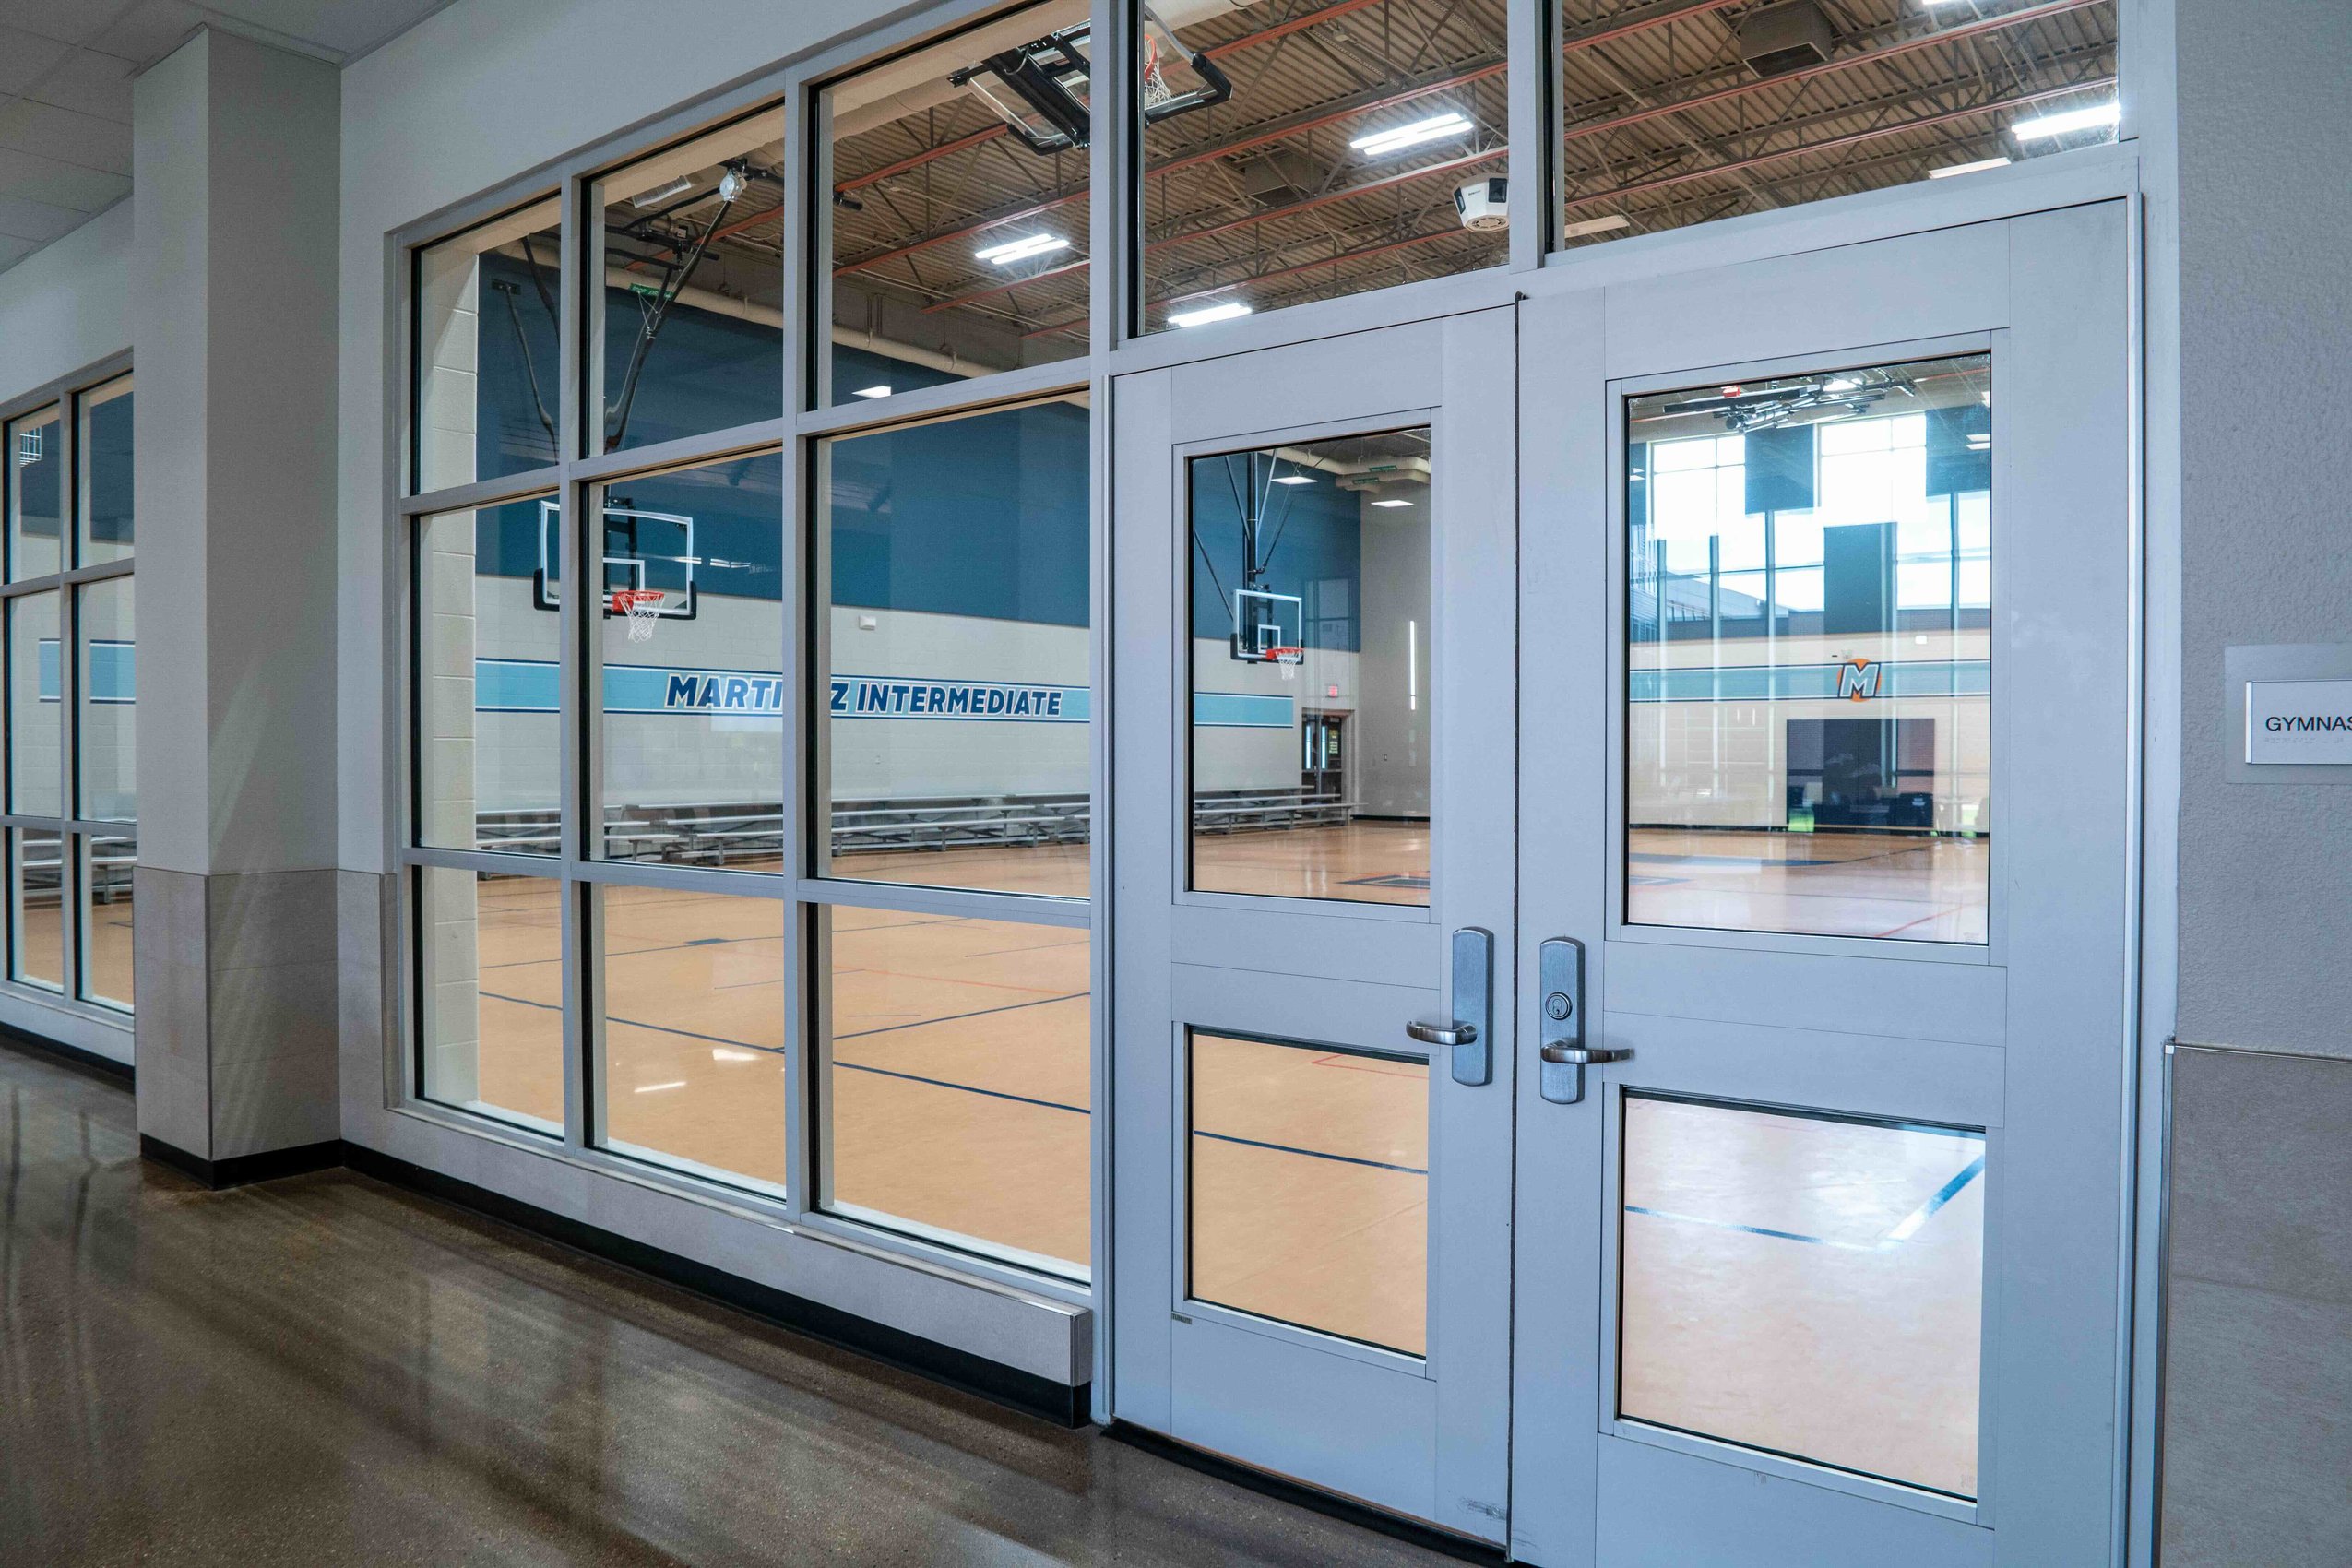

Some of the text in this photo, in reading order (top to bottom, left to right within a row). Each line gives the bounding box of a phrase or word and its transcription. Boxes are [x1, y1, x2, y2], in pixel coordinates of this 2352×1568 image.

[664, 673, 1062, 718] MARTIZ INTERMEDIATE
[1837, 662, 1881, 699] M
